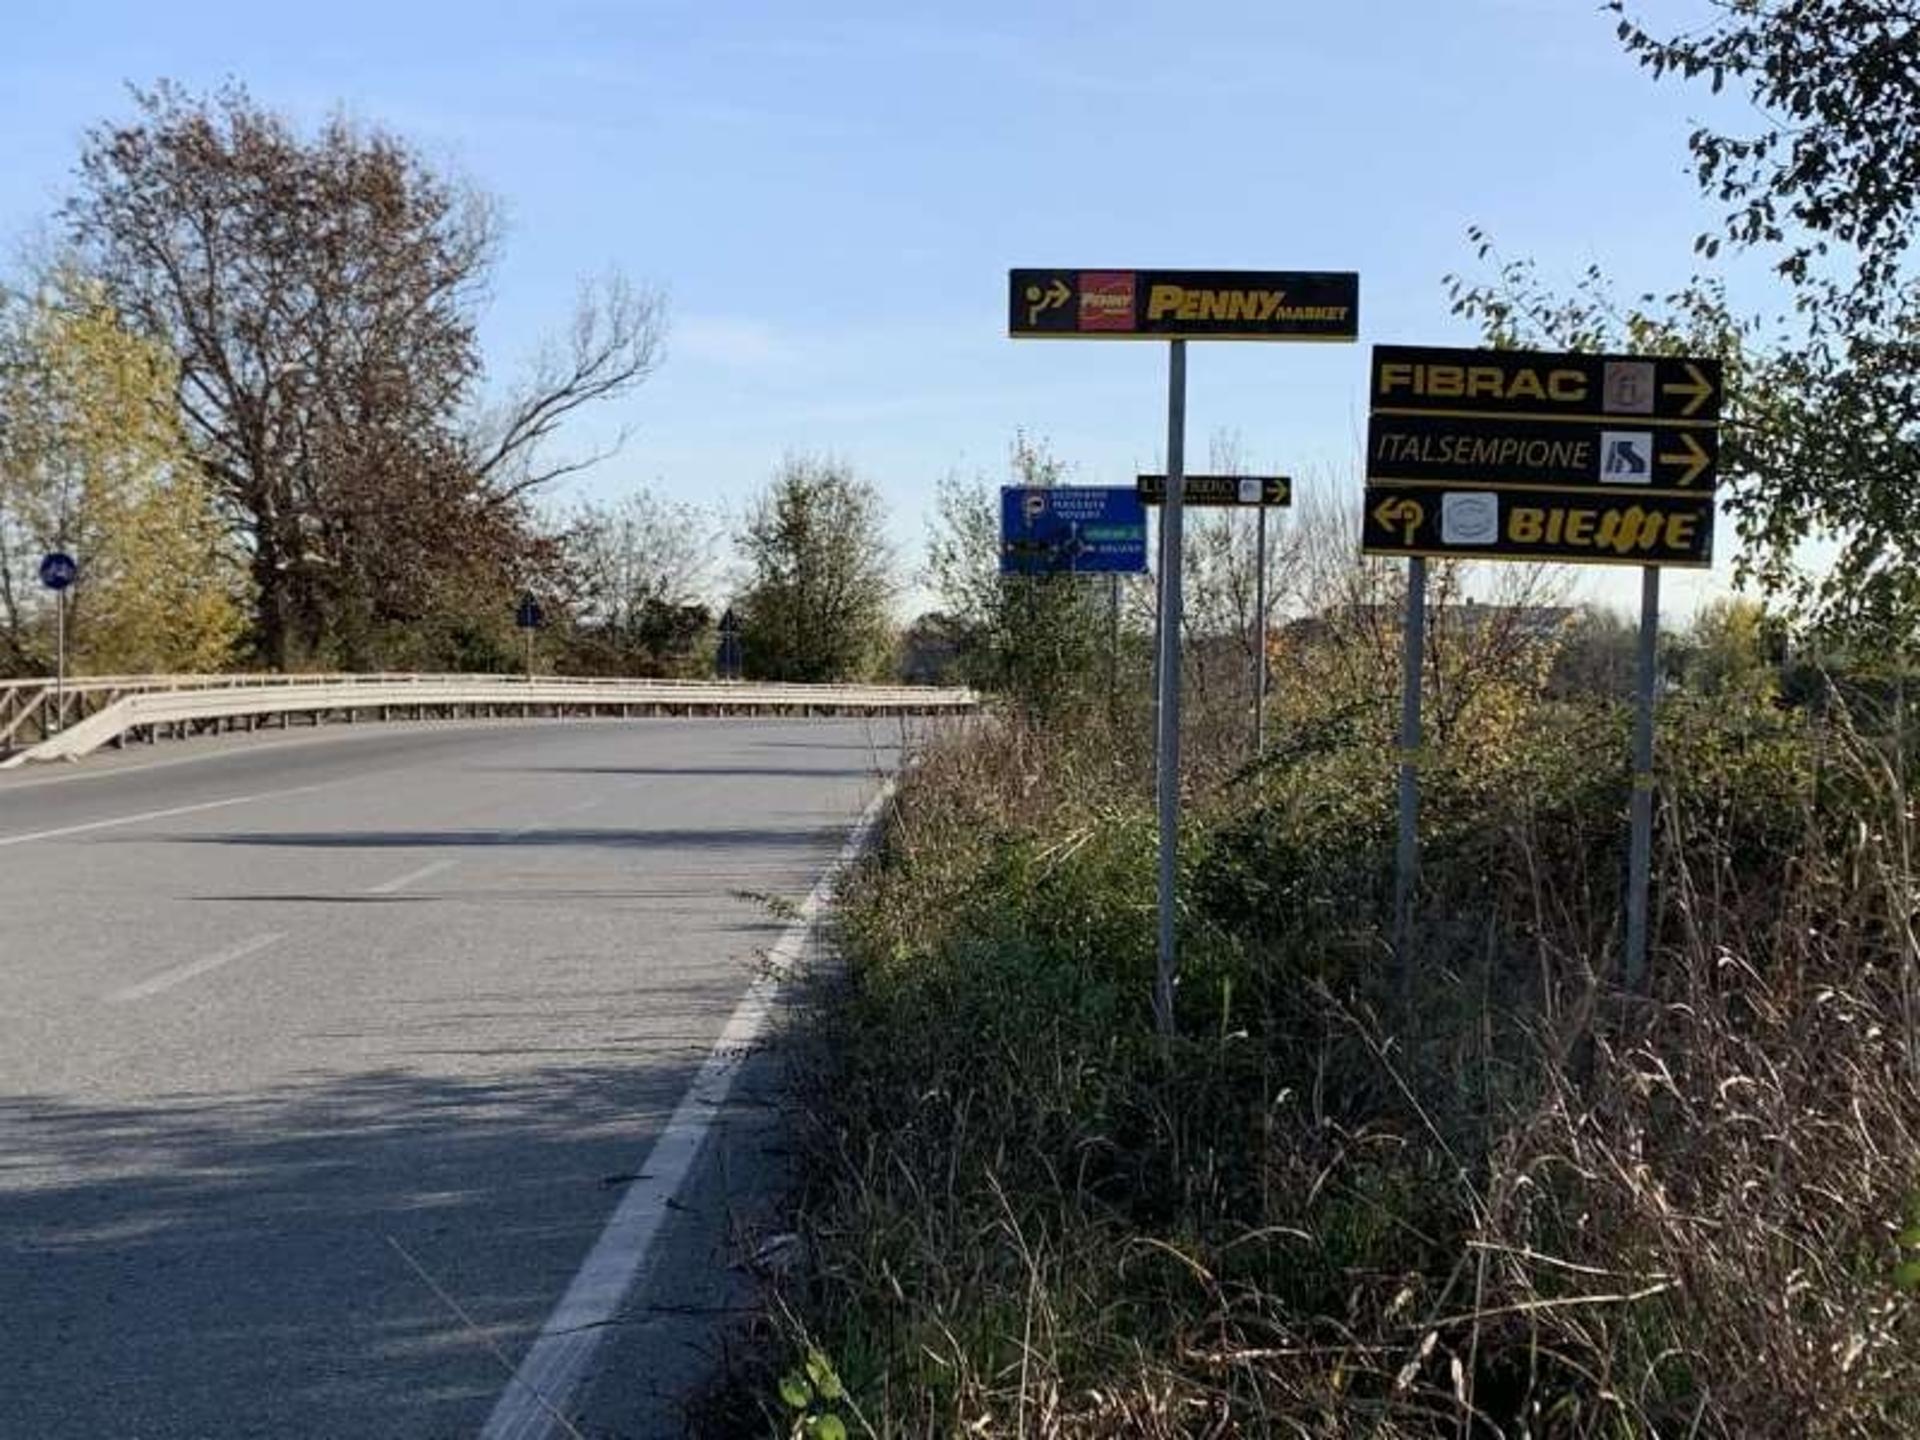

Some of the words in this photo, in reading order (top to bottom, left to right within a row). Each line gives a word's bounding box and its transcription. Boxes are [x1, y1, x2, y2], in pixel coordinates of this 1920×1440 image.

[1148, 284, 1285, 320] PENNY
[1275, 306, 1348, 321] MARKET
[1380, 363, 1588, 401] FIBRAC
[1377, 433, 1591, 469] ITALSEMPIONE
